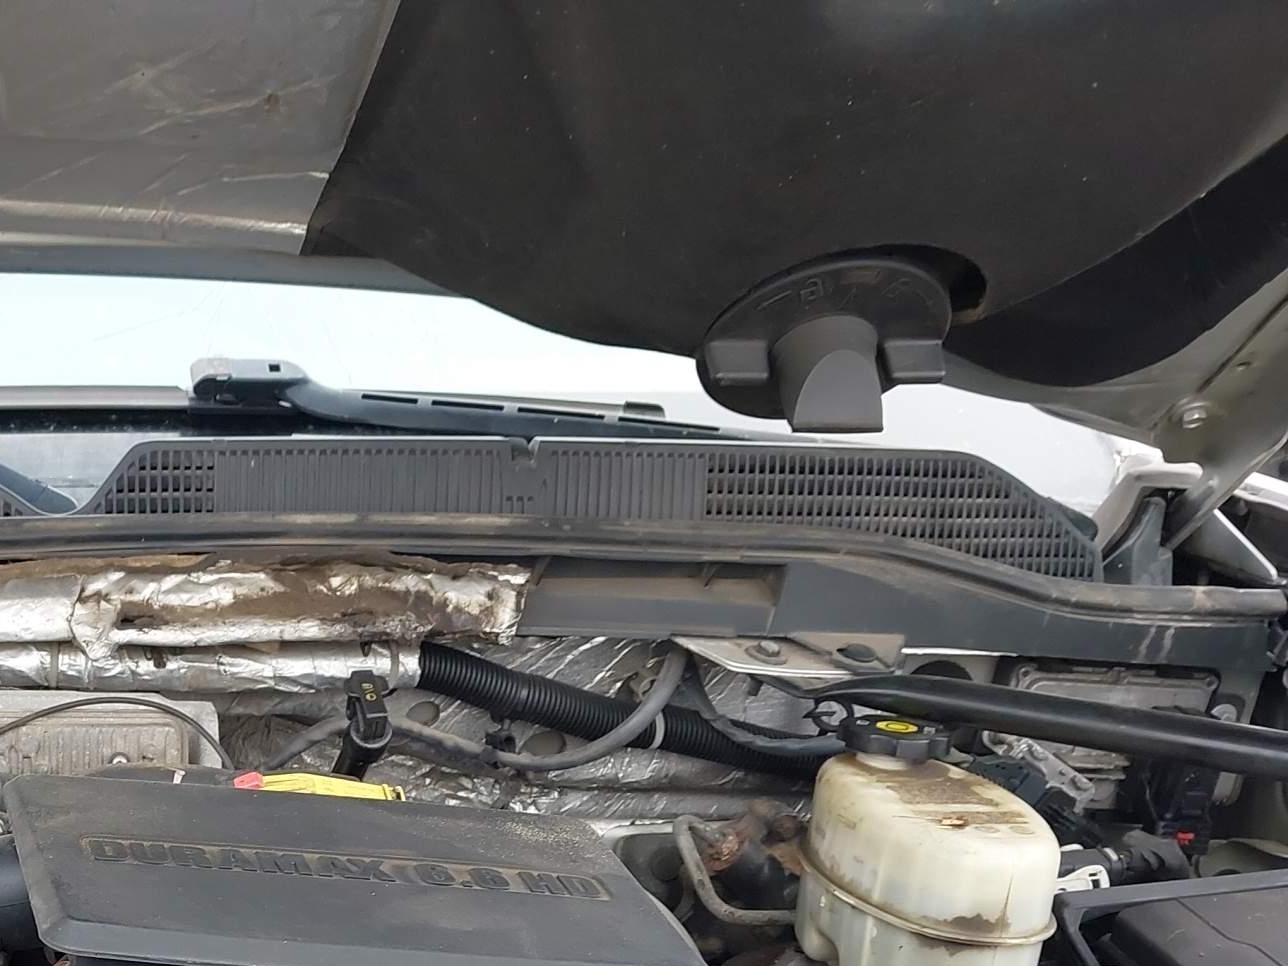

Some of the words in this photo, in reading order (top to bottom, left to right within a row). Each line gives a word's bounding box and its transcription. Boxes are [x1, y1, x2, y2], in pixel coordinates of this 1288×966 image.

[89, 836, 397, 884] DURAMAX
[419, 863, 513, 892] 6.6
[524, 871, 607, 900] HD
